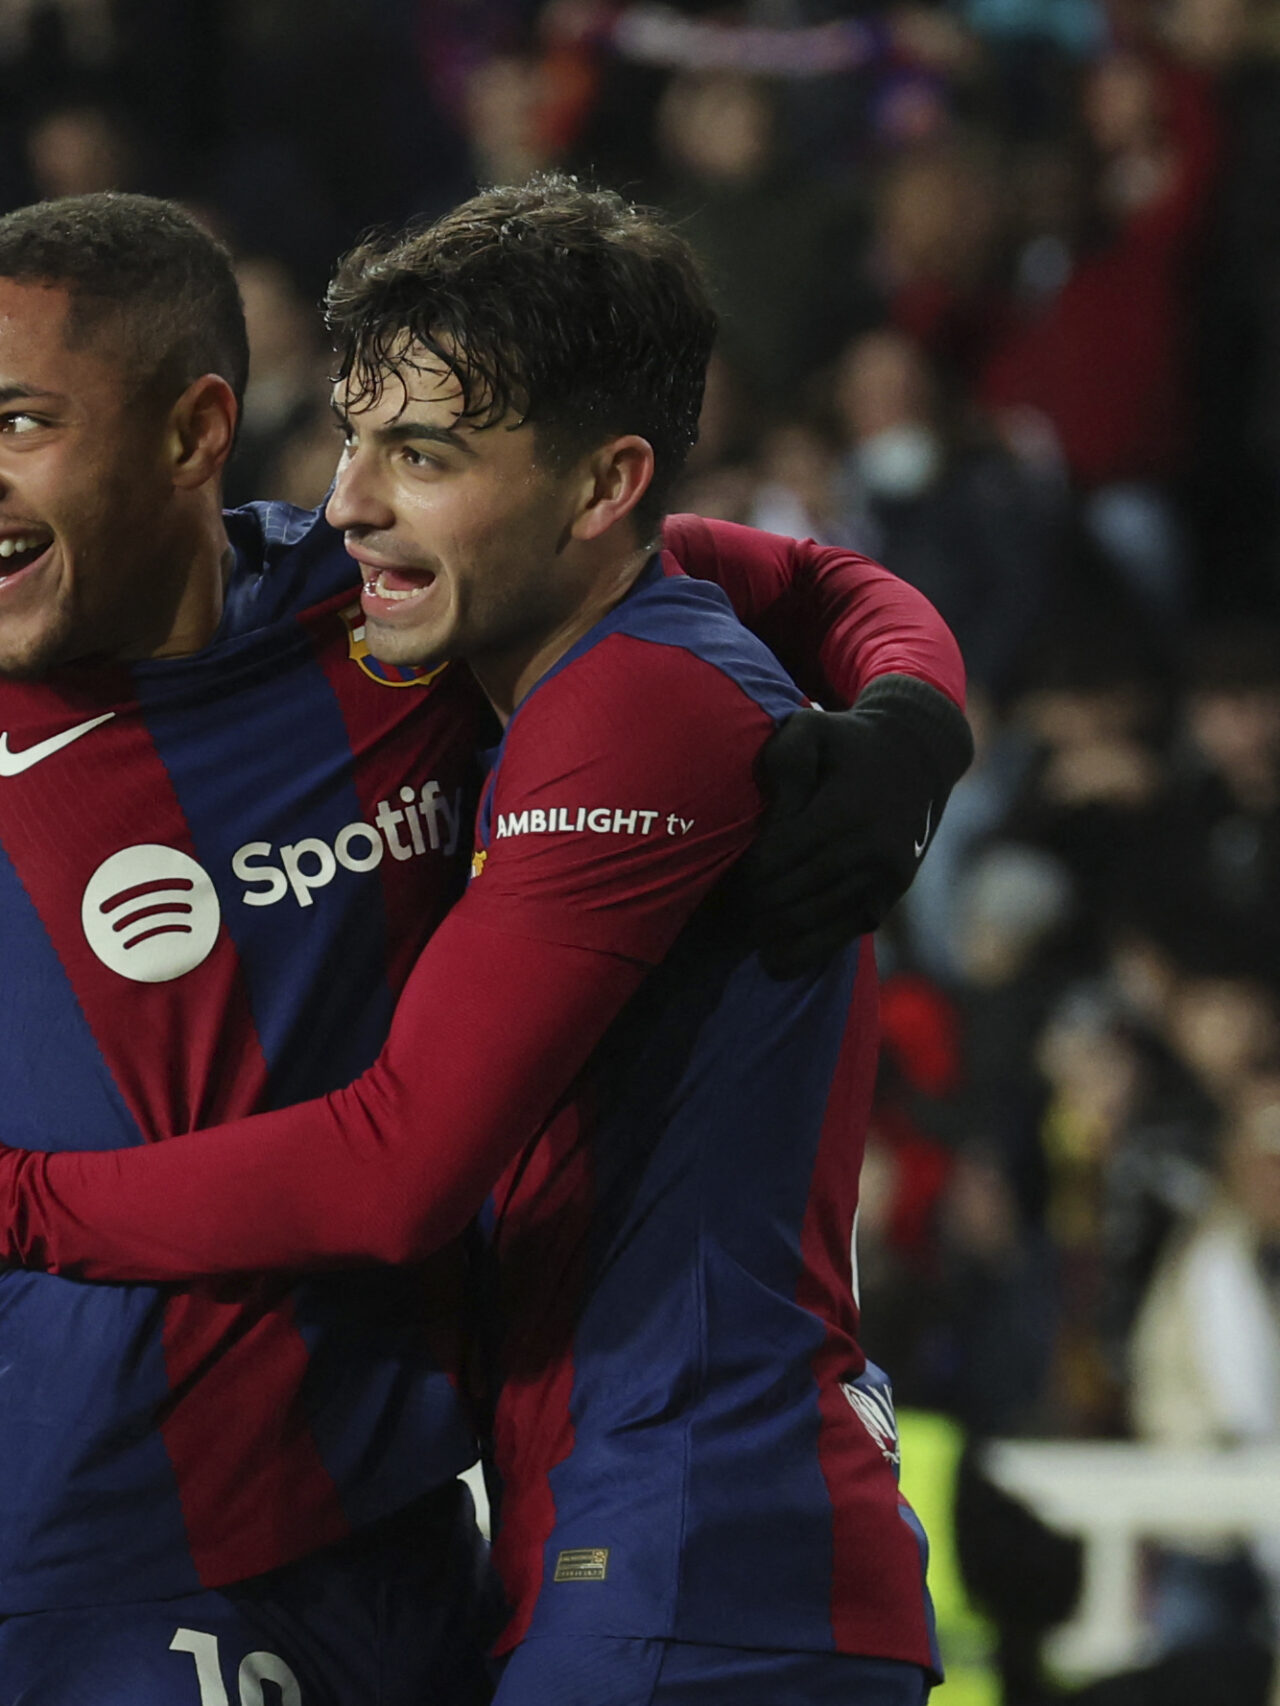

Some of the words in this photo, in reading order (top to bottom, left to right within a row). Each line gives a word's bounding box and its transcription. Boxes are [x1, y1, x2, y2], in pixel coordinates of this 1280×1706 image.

[232, 780, 461, 907] Spotify
[496, 807, 659, 840] AMBILIGHT
[666, 813, 695, 836] tv
